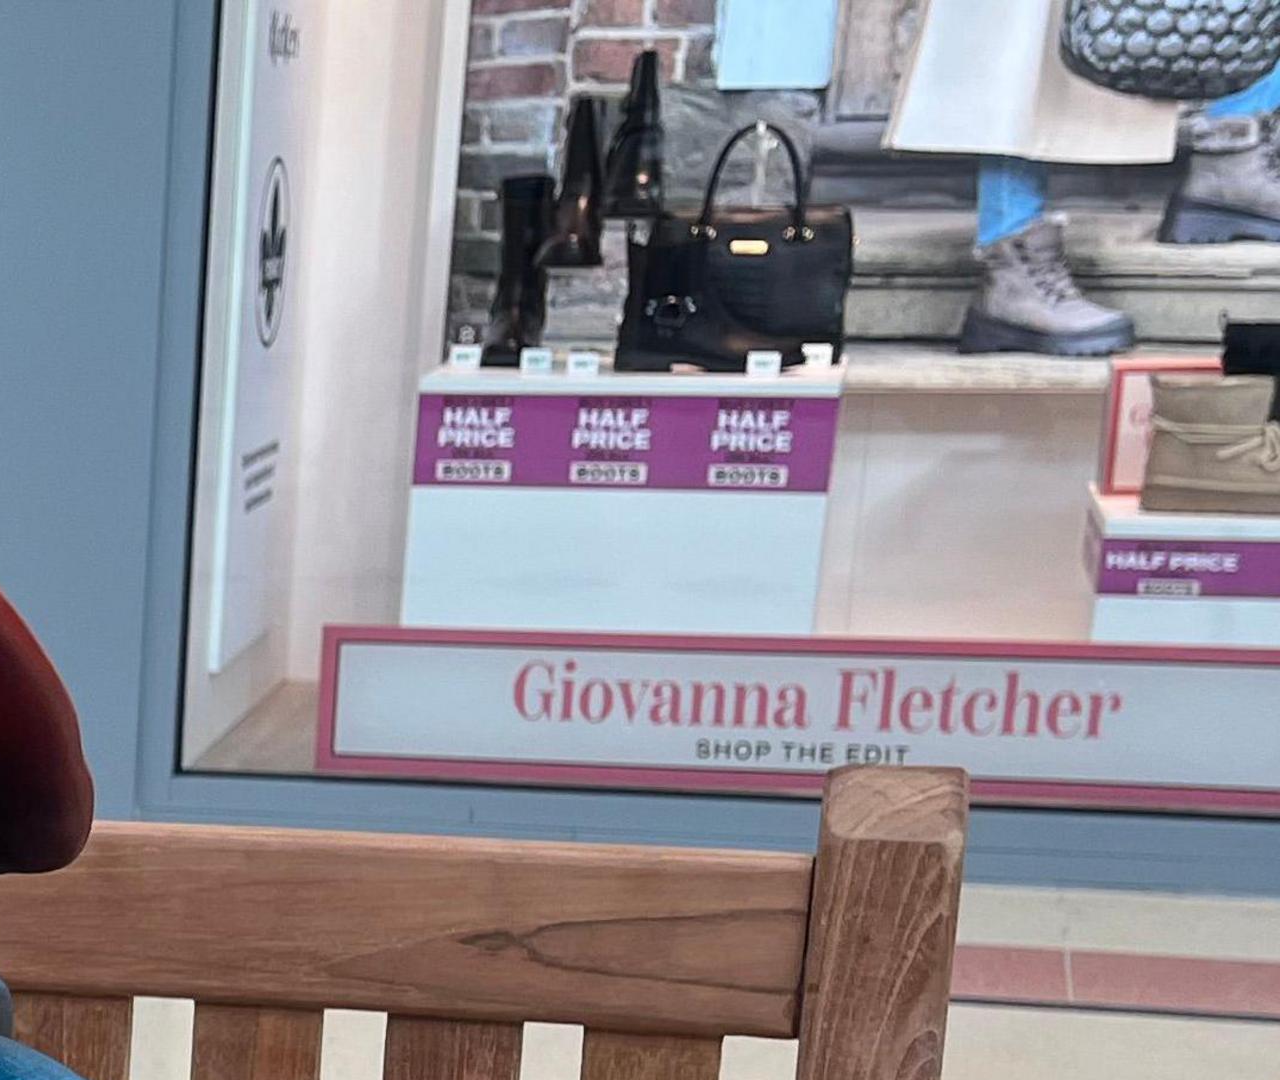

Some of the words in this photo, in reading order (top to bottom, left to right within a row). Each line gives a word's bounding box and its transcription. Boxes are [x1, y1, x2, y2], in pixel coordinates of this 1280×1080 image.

[443, 407, 512, 428] HALF
[578, 408, 649, 429] HALF
[718, 409, 790, 431] HALF
[438, 427, 515, 449] PRICE
[572, 428, 650, 451] PRICE
[711, 430, 792, 453] PRICE
[441, 463, 506, 481] BOOTS
[576, 465, 641, 483] BOOTS
[714, 469, 781, 486] BOOTS
[1105, 551, 1166, 571] HALF
[1169, 552, 1240, 573] PRICE
[512, 658, 808, 729] Giovanna
[835, 667, 1124, 740] Fletcher
[695, 739, 771, 763] SHOP
[781, 741, 834, 764] THE
[845, 744, 912, 767] EDIT
